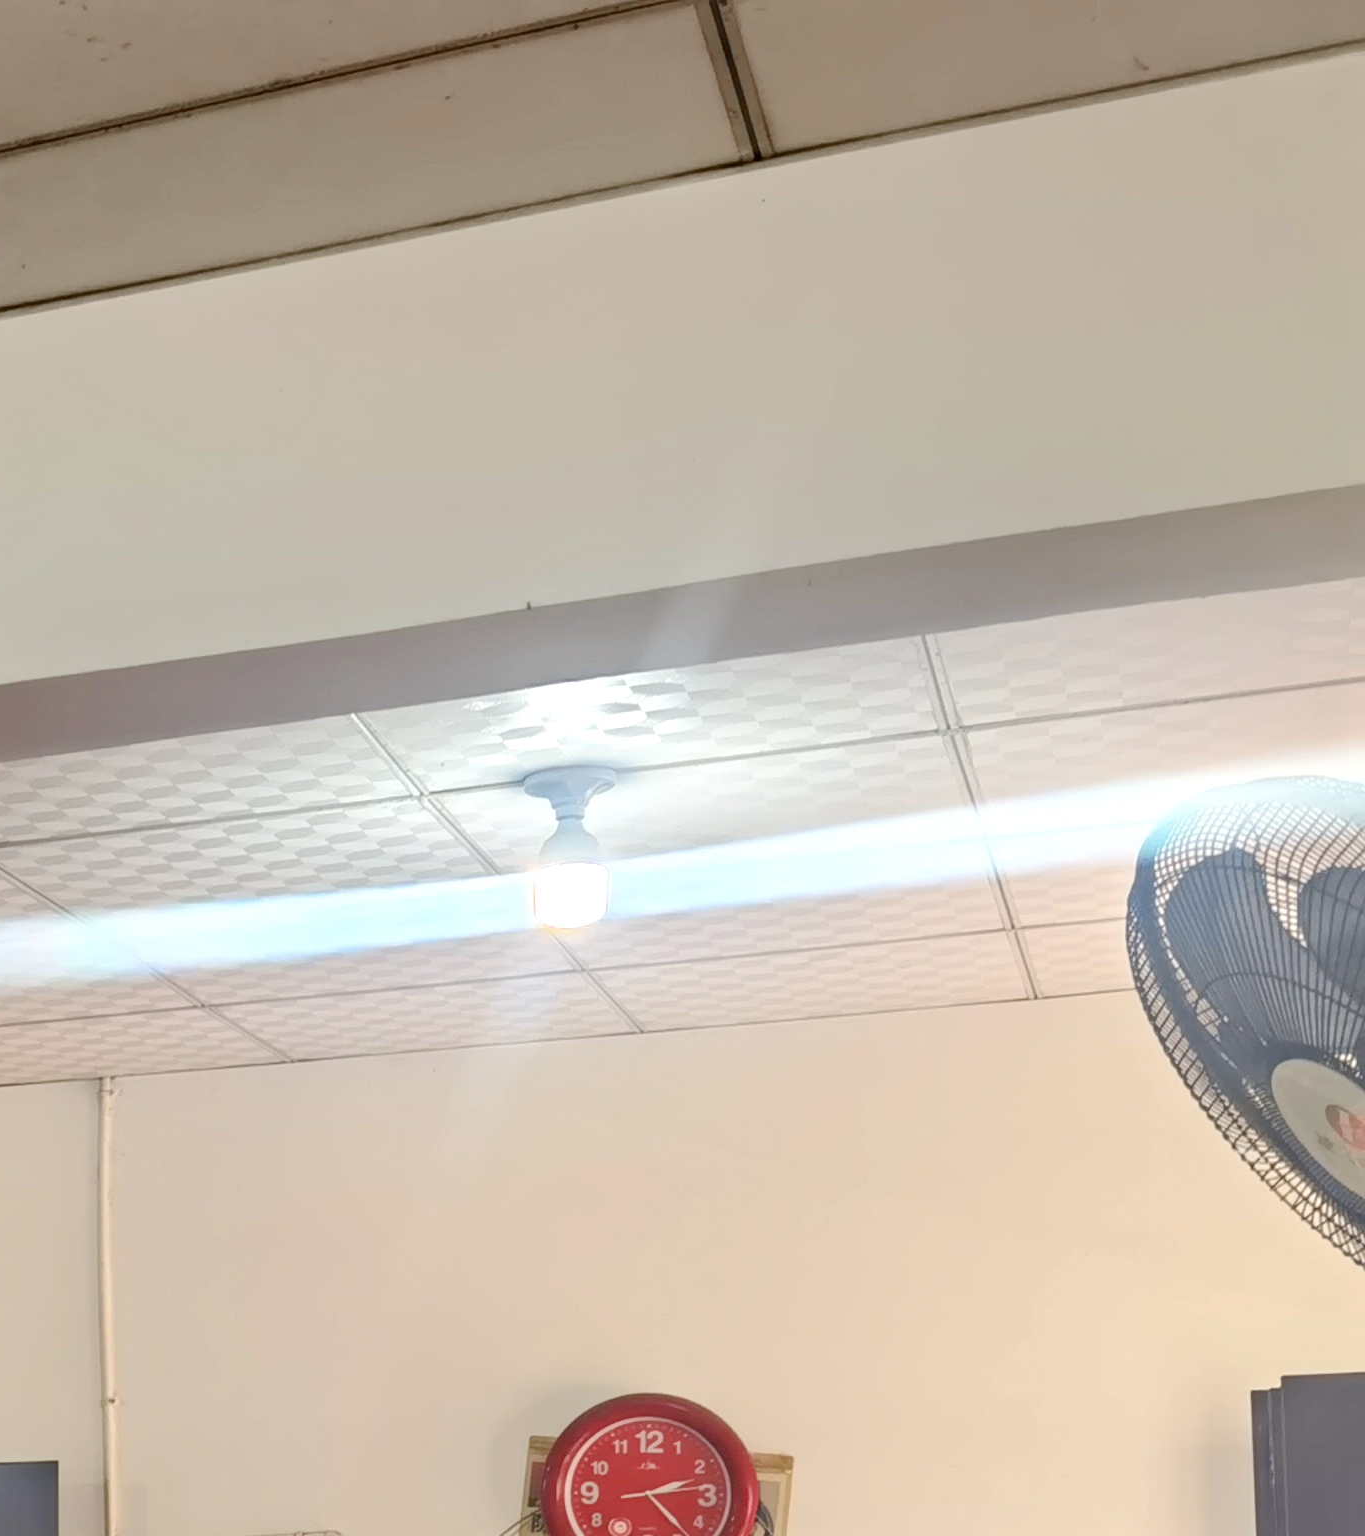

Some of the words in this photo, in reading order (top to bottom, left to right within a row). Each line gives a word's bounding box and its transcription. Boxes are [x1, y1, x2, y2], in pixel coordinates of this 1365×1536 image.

[611, 1438, 629, 1455] 11
[634, 1429, 665, 1454] 12
[672, 1439, 682, 1456] 1
[590, 1460, 610, 1476] 10
[693, 1458, 706, 1475] 2
[579, 1480, 600, 1505] 9
[696, 1483, 718, 1508] 3
[590, 1512, 603, 1528] 8
[692, 1514, 705, 1530] 4
